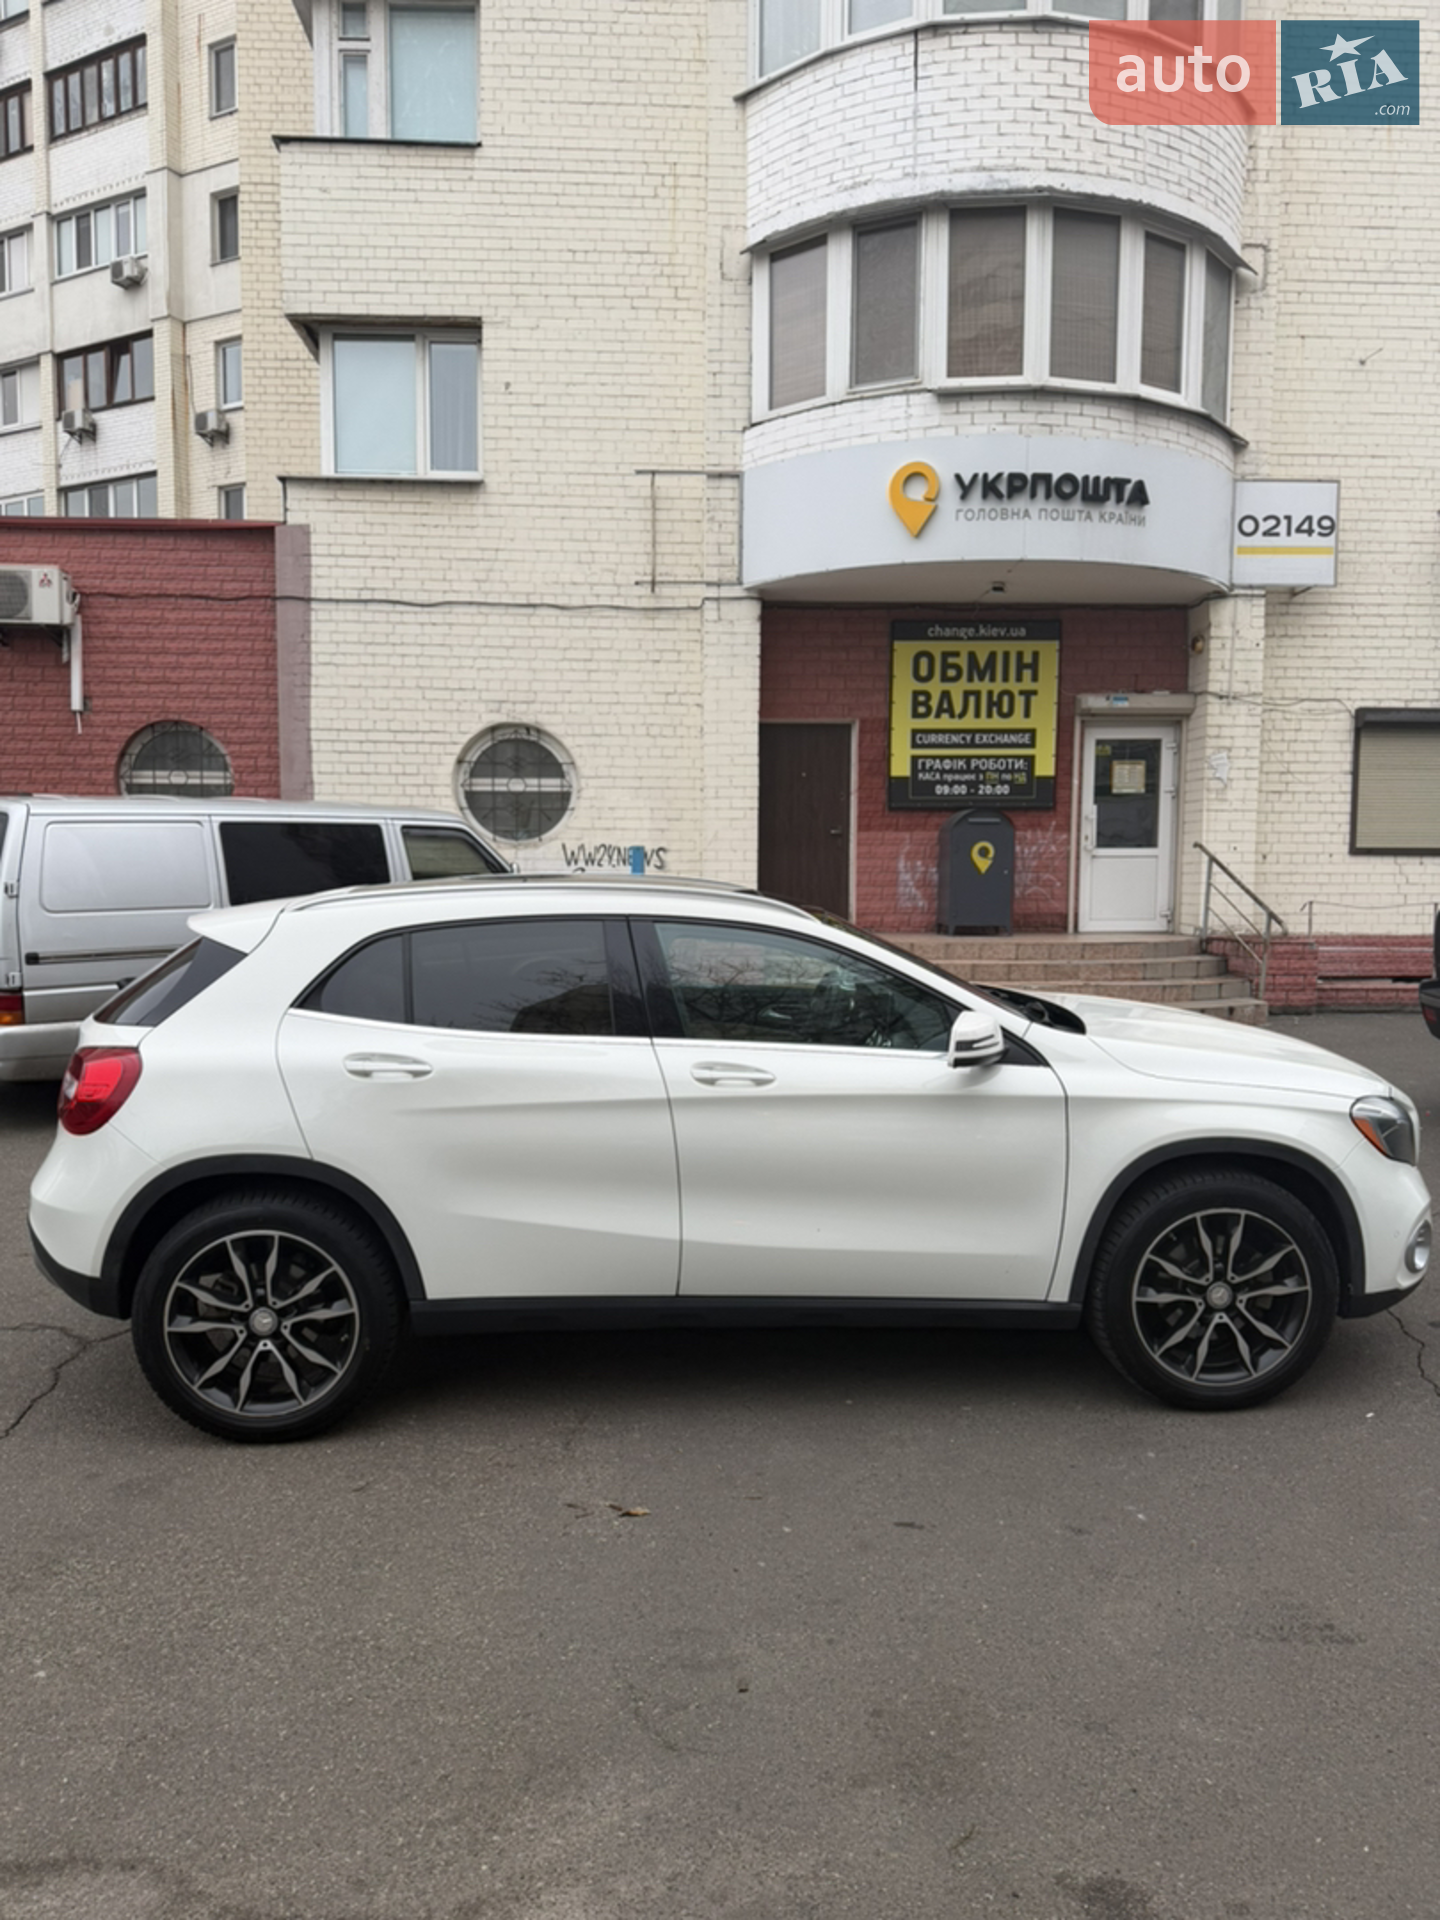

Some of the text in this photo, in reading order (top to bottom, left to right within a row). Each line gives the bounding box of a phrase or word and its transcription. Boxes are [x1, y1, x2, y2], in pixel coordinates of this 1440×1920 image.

[954, 472, 1150, 506] УКРПОШТА
[955, 508, 1147, 527] ГОЛОВНА ПОШТА КРАЇНИ
[1237, 514, 1336, 538] 02149
[927, 624, 1027, 640] change.kiev.ua
[911, 650, 1040, 684] ОБМІН
[910, 689, 1039, 720] ВАЛЮТ
[915, 733, 1032, 744] CURRENCY EXCHANGE
[917, 758, 1028, 770] ГРАФІК РОБОТИ:
[935, 784, 967, 795] 09:00
[978, 784, 1011, 795] 20:00
